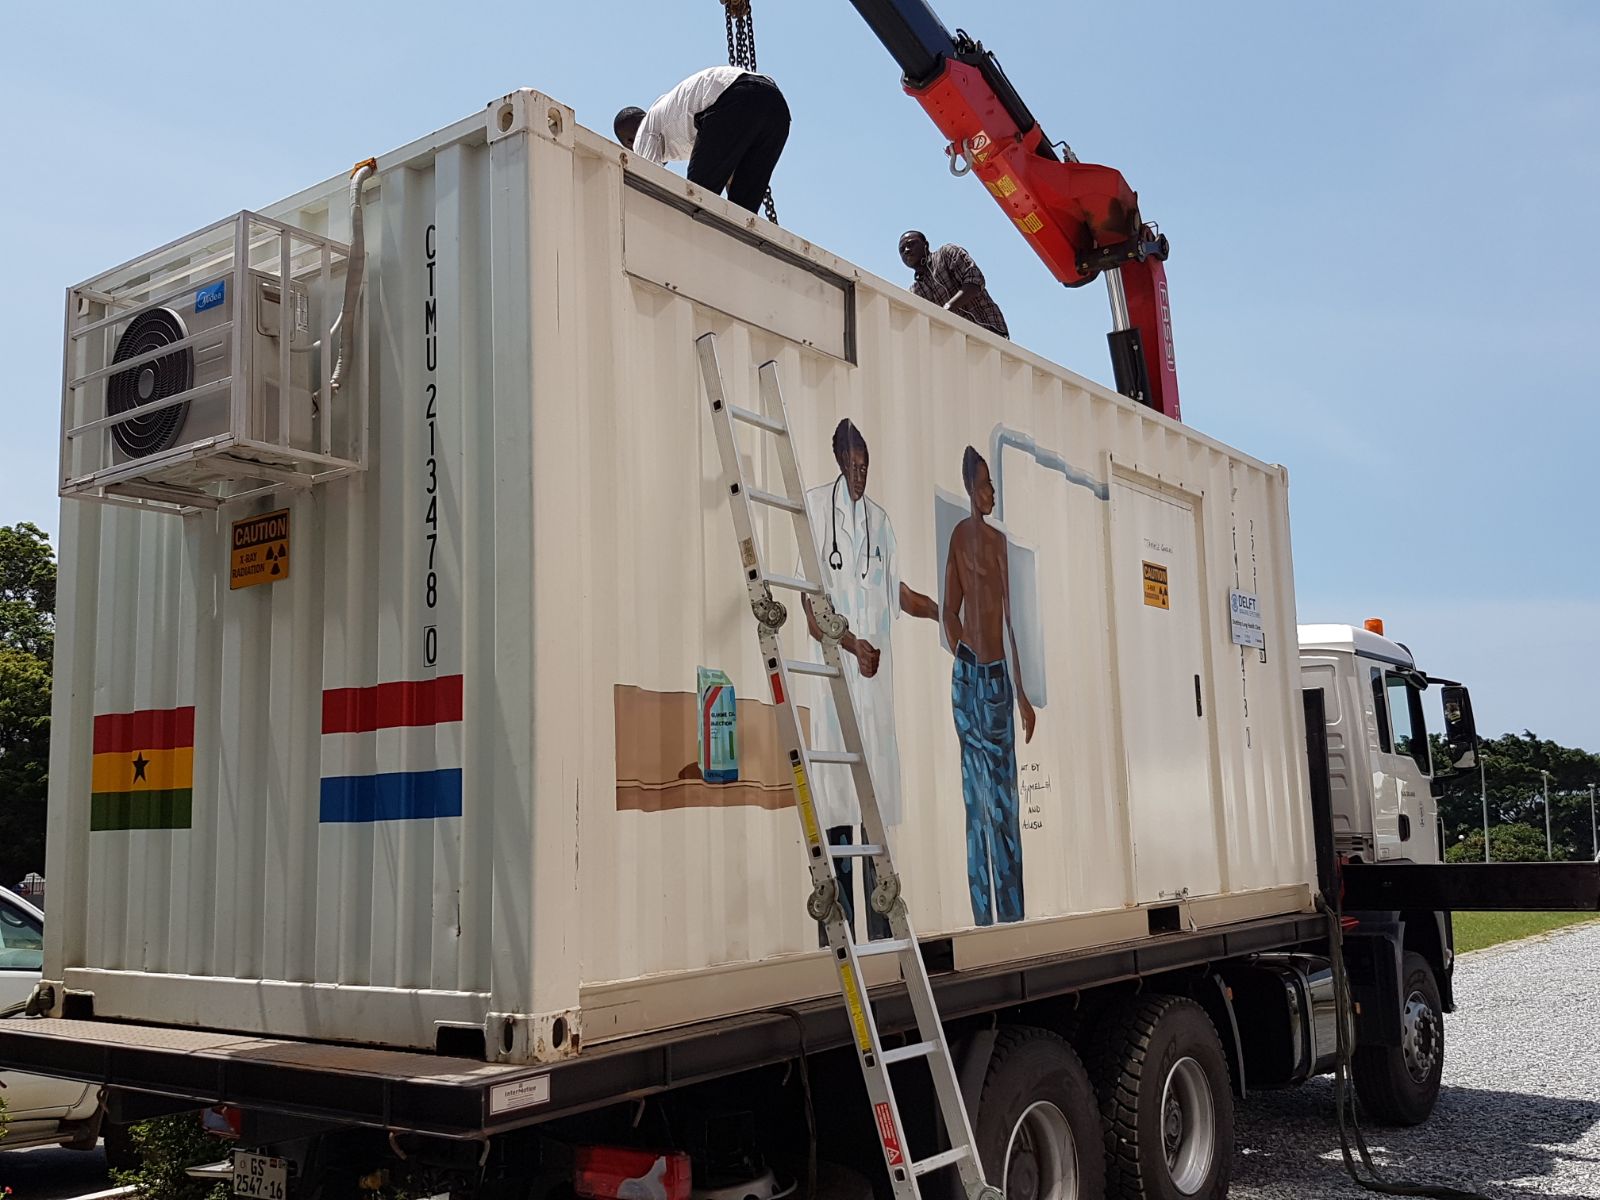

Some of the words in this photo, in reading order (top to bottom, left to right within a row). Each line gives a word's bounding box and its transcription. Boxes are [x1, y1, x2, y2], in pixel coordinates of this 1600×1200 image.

[201, 291, 222, 305] Midea
[425, 224, 437, 372] CTMU
[1160, 287, 1175, 366] FASSI
[425, 383, 437, 608] 213478
[235, 517, 286, 546] CAUTION
[240, 551, 257, 564] X-RAY
[232, 563, 265, 579] RADIATION
[1238, 594, 1256, 611] DELFT
[251, 1157, 266, 1176] GS
